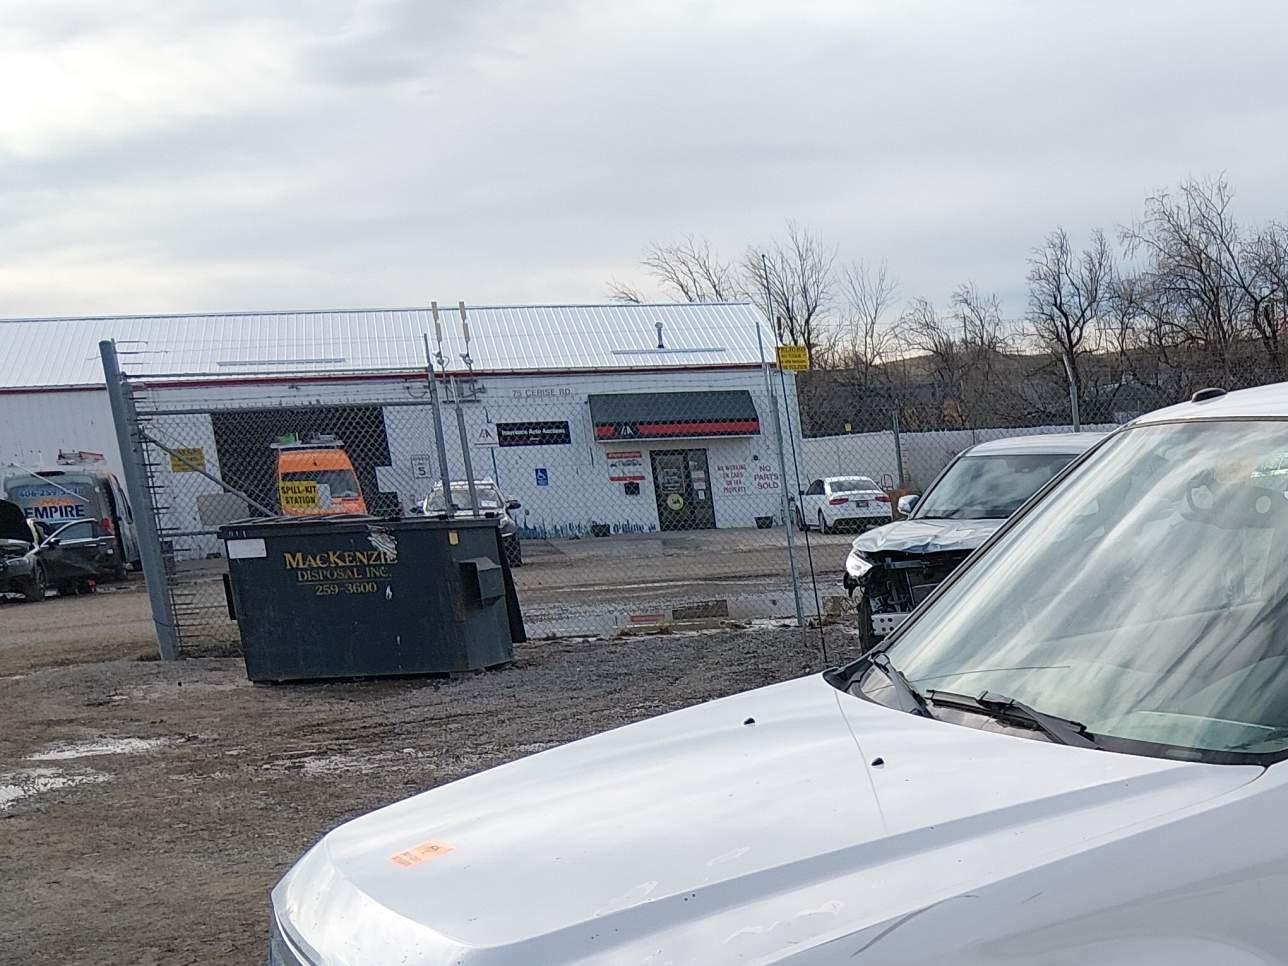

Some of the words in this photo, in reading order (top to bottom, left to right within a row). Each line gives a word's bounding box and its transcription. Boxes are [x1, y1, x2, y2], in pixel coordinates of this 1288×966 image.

[418, 467, 426, 475] 5
[754, 473, 779, 481] PARTS
[758, 481, 779, 490] SOLD
[286, 496, 316, 504] STATION
[24, 504, 86, 518] EMPIRE
[297, 568, 362, 582] DISPOSAL
[366, 567, 393, 578] INC.
[315, 582, 377, 596] 259-3600
